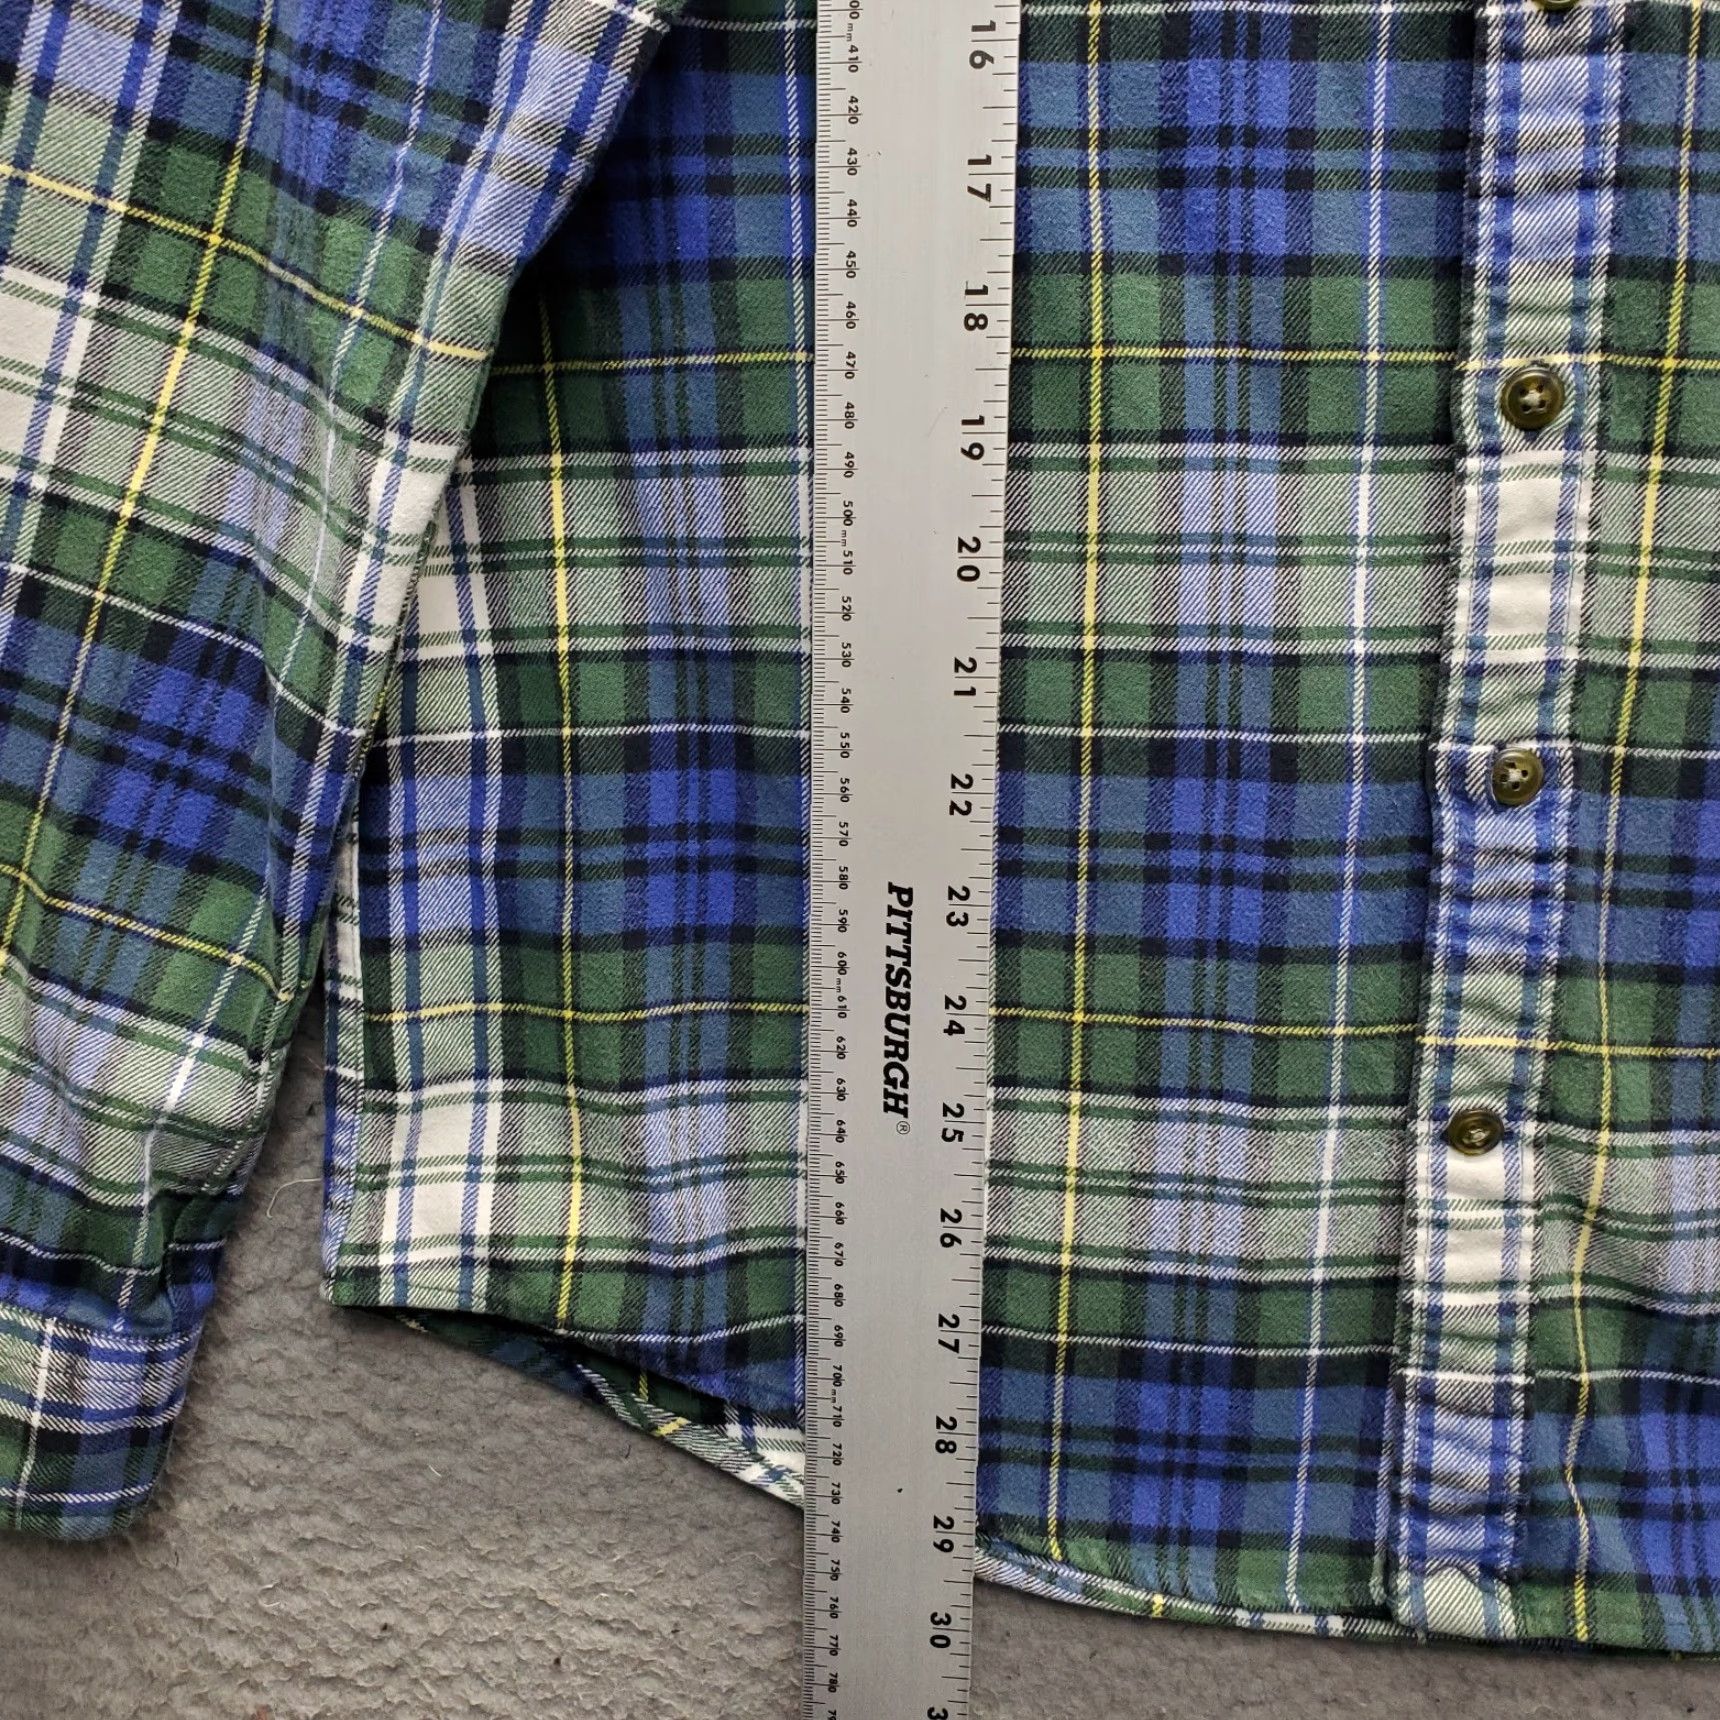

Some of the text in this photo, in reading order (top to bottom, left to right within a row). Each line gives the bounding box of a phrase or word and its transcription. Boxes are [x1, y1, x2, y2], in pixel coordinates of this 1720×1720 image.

[846, 23, 853, 42] mm
[969, 20, 996, 69] 16
[848, 45, 858, 73] 410
[848, 96, 858, 124] 420
[847, 148, 857, 176] 430
[967, 154, 992, 202] 17
[847, 199, 857, 227] 440
[846, 251, 856, 278] 450
[846, 301, 856, 329] 460
[964, 285, 988, 331] 18
[845, 352, 856, 379] 470
[845, 402, 855, 429] 480
[961, 415, 985, 460] 19
[844, 452, 855, 478] 490
[840, 501, 853, 547] 500 mm
[843, 550, 853, 575] 510
[957, 536, 981, 582] 20
[842, 596, 852, 621] 520
[842, 642, 852, 668] 530
[953, 657, 978, 696] 21
[841, 688, 852, 713] 540
[840, 732, 850, 758] 550
[840, 778, 850, 802] 560
[949, 774, 974, 816] 22
[839, 822, 849, 847] 570
[839, 866, 848, 890] 580
[946, 886, 970, 927] 23
[838, 909, 848, 933] 590
[836, 951, 847, 993] 600 mm
[837, 995, 847, 1019] 610
[883, 882, 913, 1118] PITTSBURGH
[944, 995, 967, 1036] 24
[836, 1036, 846, 1059] 620
[836, 1078, 846, 1101] 630
[835, 1120, 846, 1143] 640
[942, 1102, 965, 1142] 25
[835, 1161, 845, 1184] 650
[835, 1202, 845, 1225] 660
[940, 1208, 963, 1248] 26
[834, 1242, 844, 1266] 670
[834, 1284, 843, 1307] 680
[834, 1325, 843, 1347] 690
[938, 1314, 960, 1353] 27
[833, 1365, 842, 1387] 700
[833, 1405, 842, 1427] 710
[935, 1415, 958, 1454] 28
[832, 1443, 842, 1465] 720
[831, 1482, 841, 1504] 730
[831, 1520, 841, 1543] 740
[933, 1515, 954, 1553] 29
[830, 1559, 840, 1581] 750
[829, 1597, 839, 1619] 760
[929, 1612, 952, 1648] 30
[829, 1635, 838, 1656] 770
[828, 1672, 838, 1693] 780
